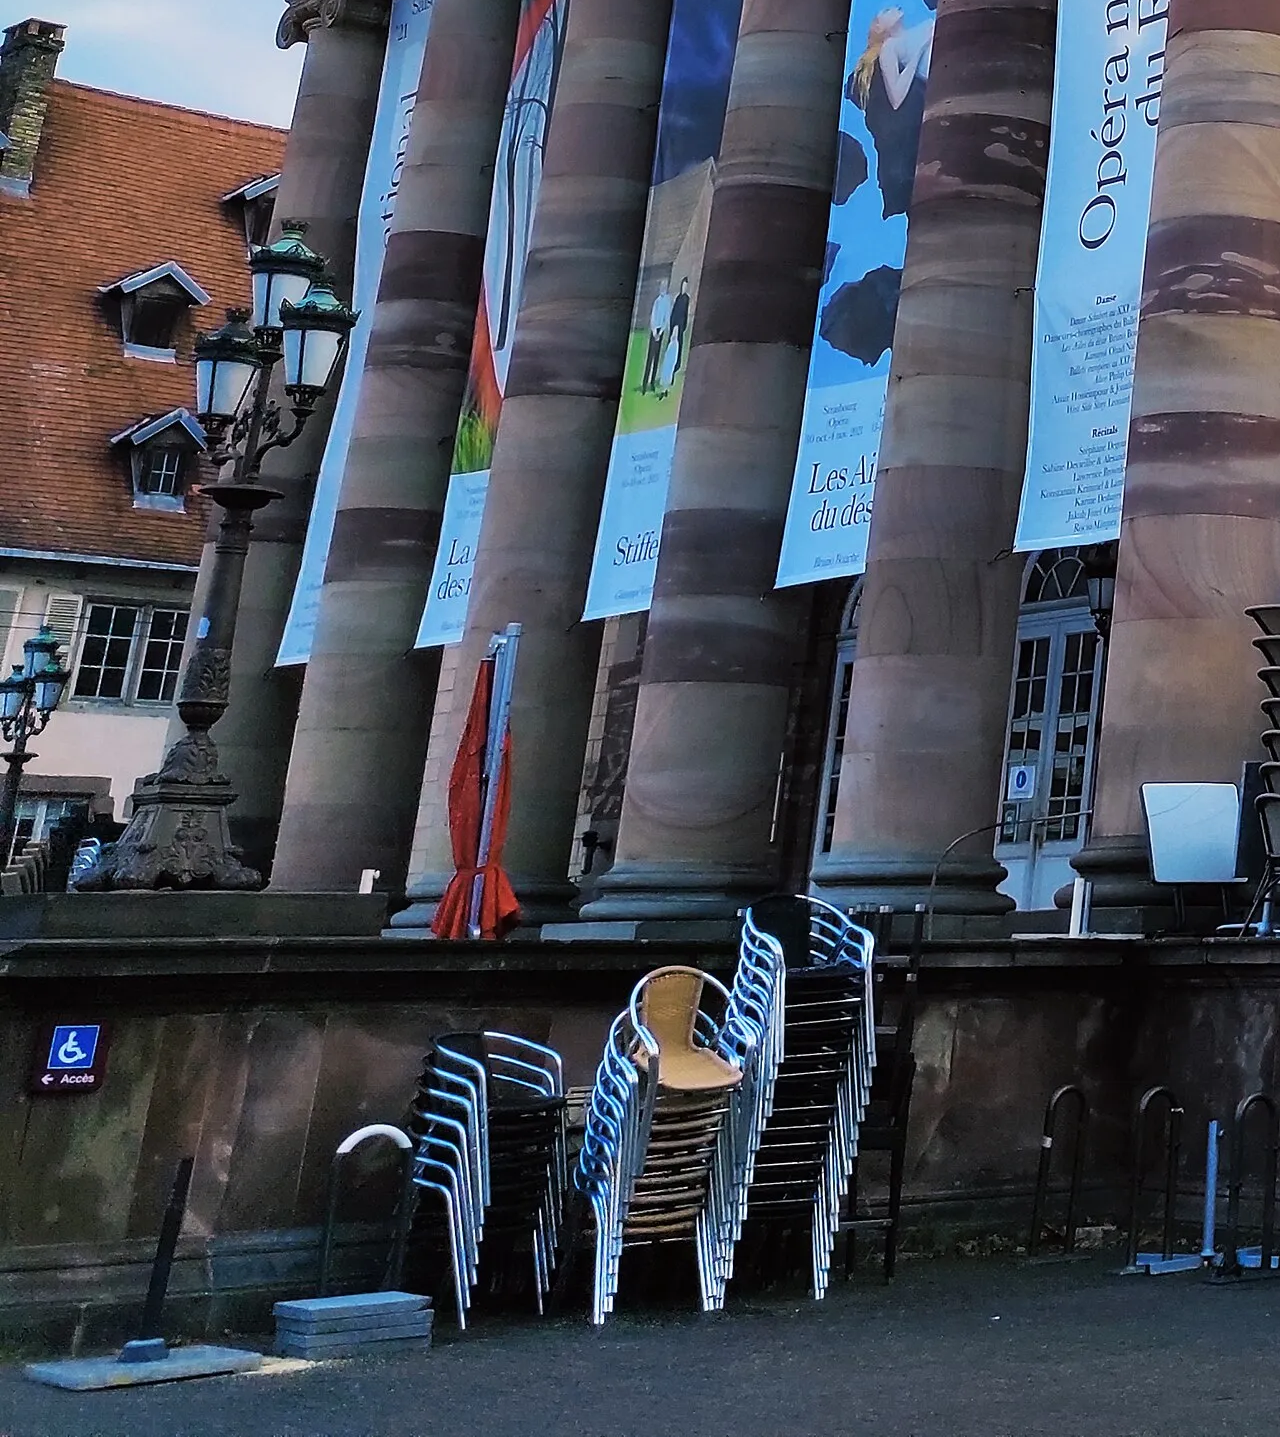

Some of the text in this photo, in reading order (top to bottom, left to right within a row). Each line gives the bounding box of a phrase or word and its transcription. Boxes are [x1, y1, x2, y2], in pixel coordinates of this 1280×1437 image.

[1079, 45, 1131, 251] Opéra
[808, 452, 877, 494] Les Ai
[811, 492, 873, 532] du dés
[447, 538, 470, 566] La
[613, 531, 659, 567] Stiffe
[437, 572, 462, 600] des
[60, 1073, 95, 1084] Accès
